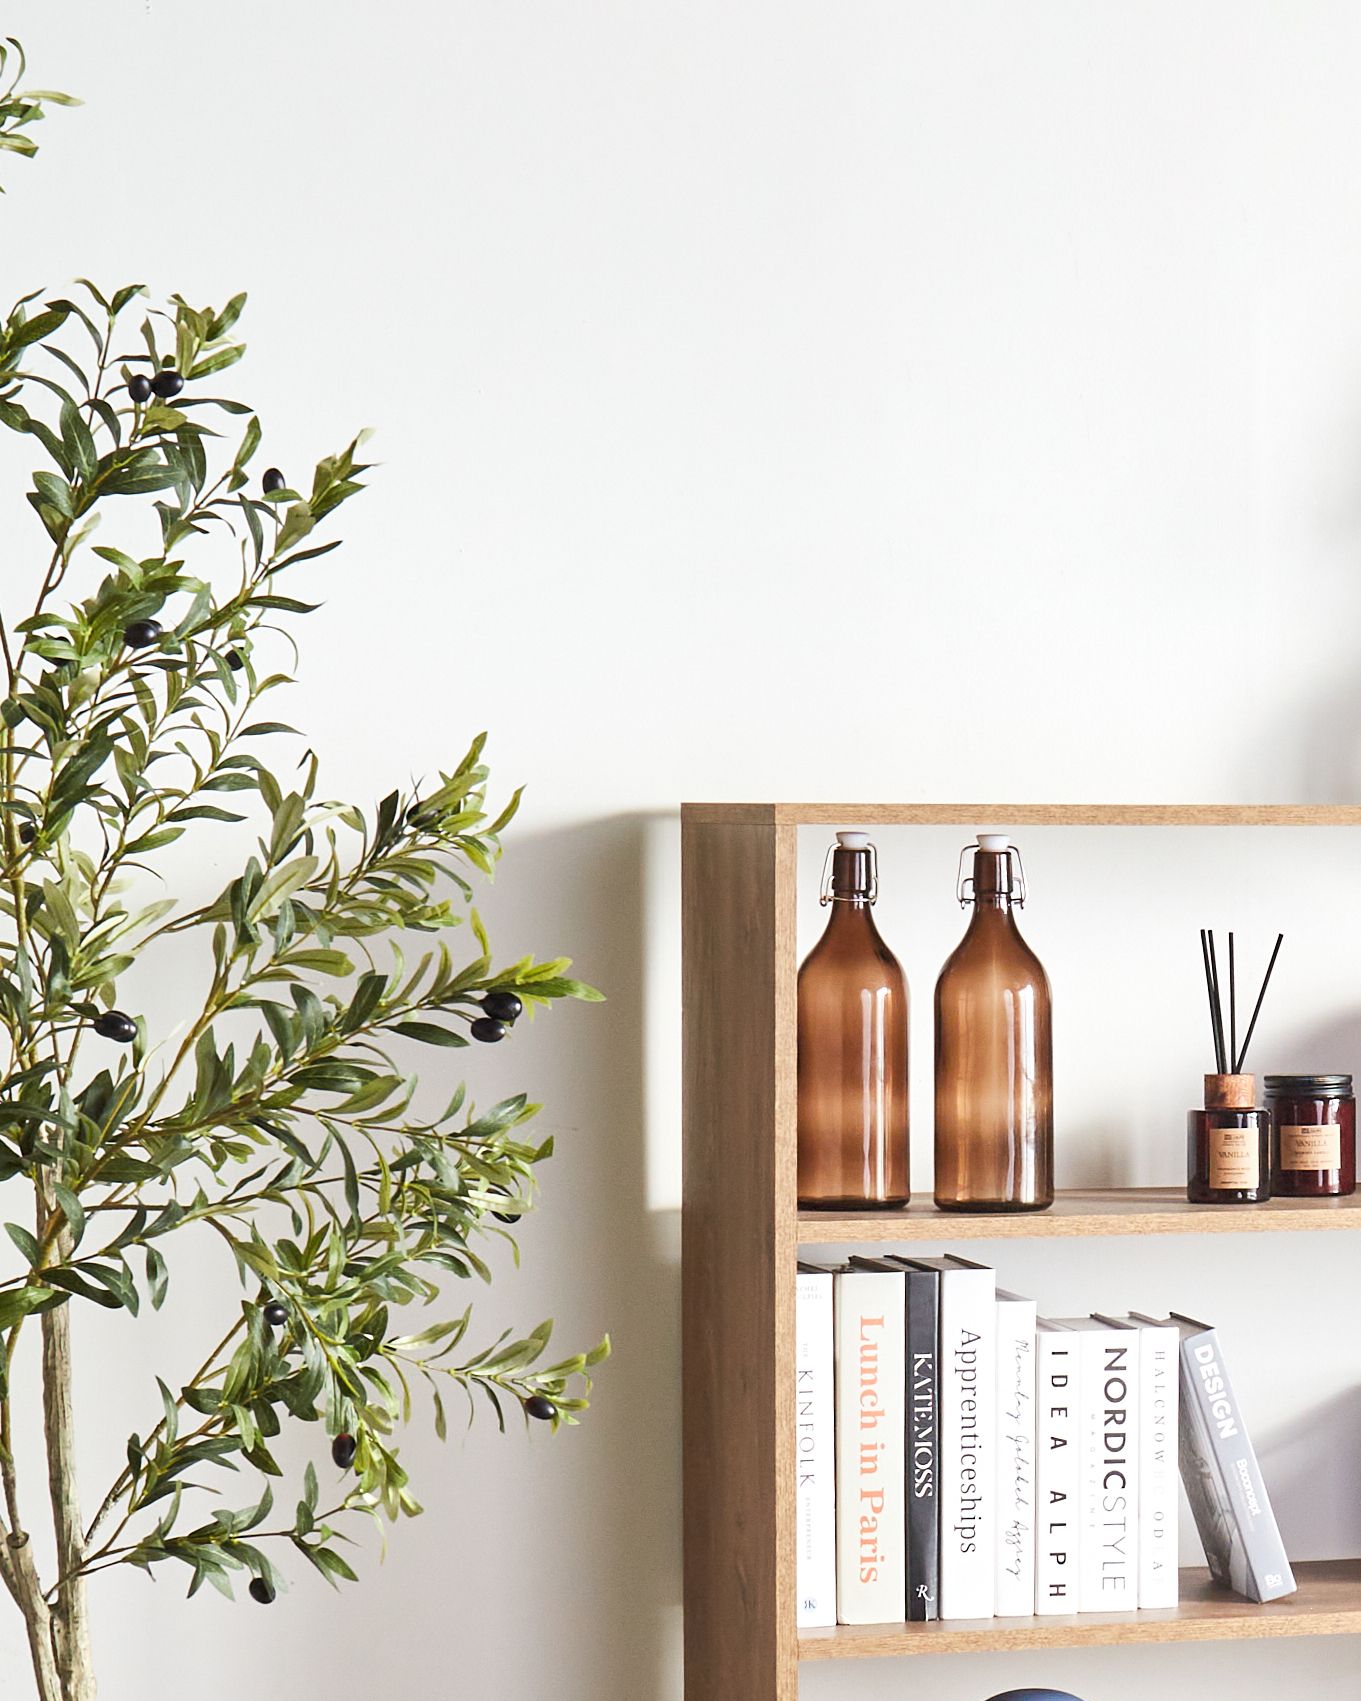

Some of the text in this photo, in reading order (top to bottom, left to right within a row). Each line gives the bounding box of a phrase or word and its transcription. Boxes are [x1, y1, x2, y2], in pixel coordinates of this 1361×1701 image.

[1218, 1151, 1251, 1159] VANILLA
[798, 1370, 815, 1489] KINFOLK
[858, 1314, 887, 1585] Lunch in Paris
[913, 1352, 934, 1499] KATE MOSS
[953, 1328, 983, 1554] Apprenticeships
[1194, 1343, 1238, 1440] DESIGN
[1048, 1350, 1069, 1598] IDEA ALPH
